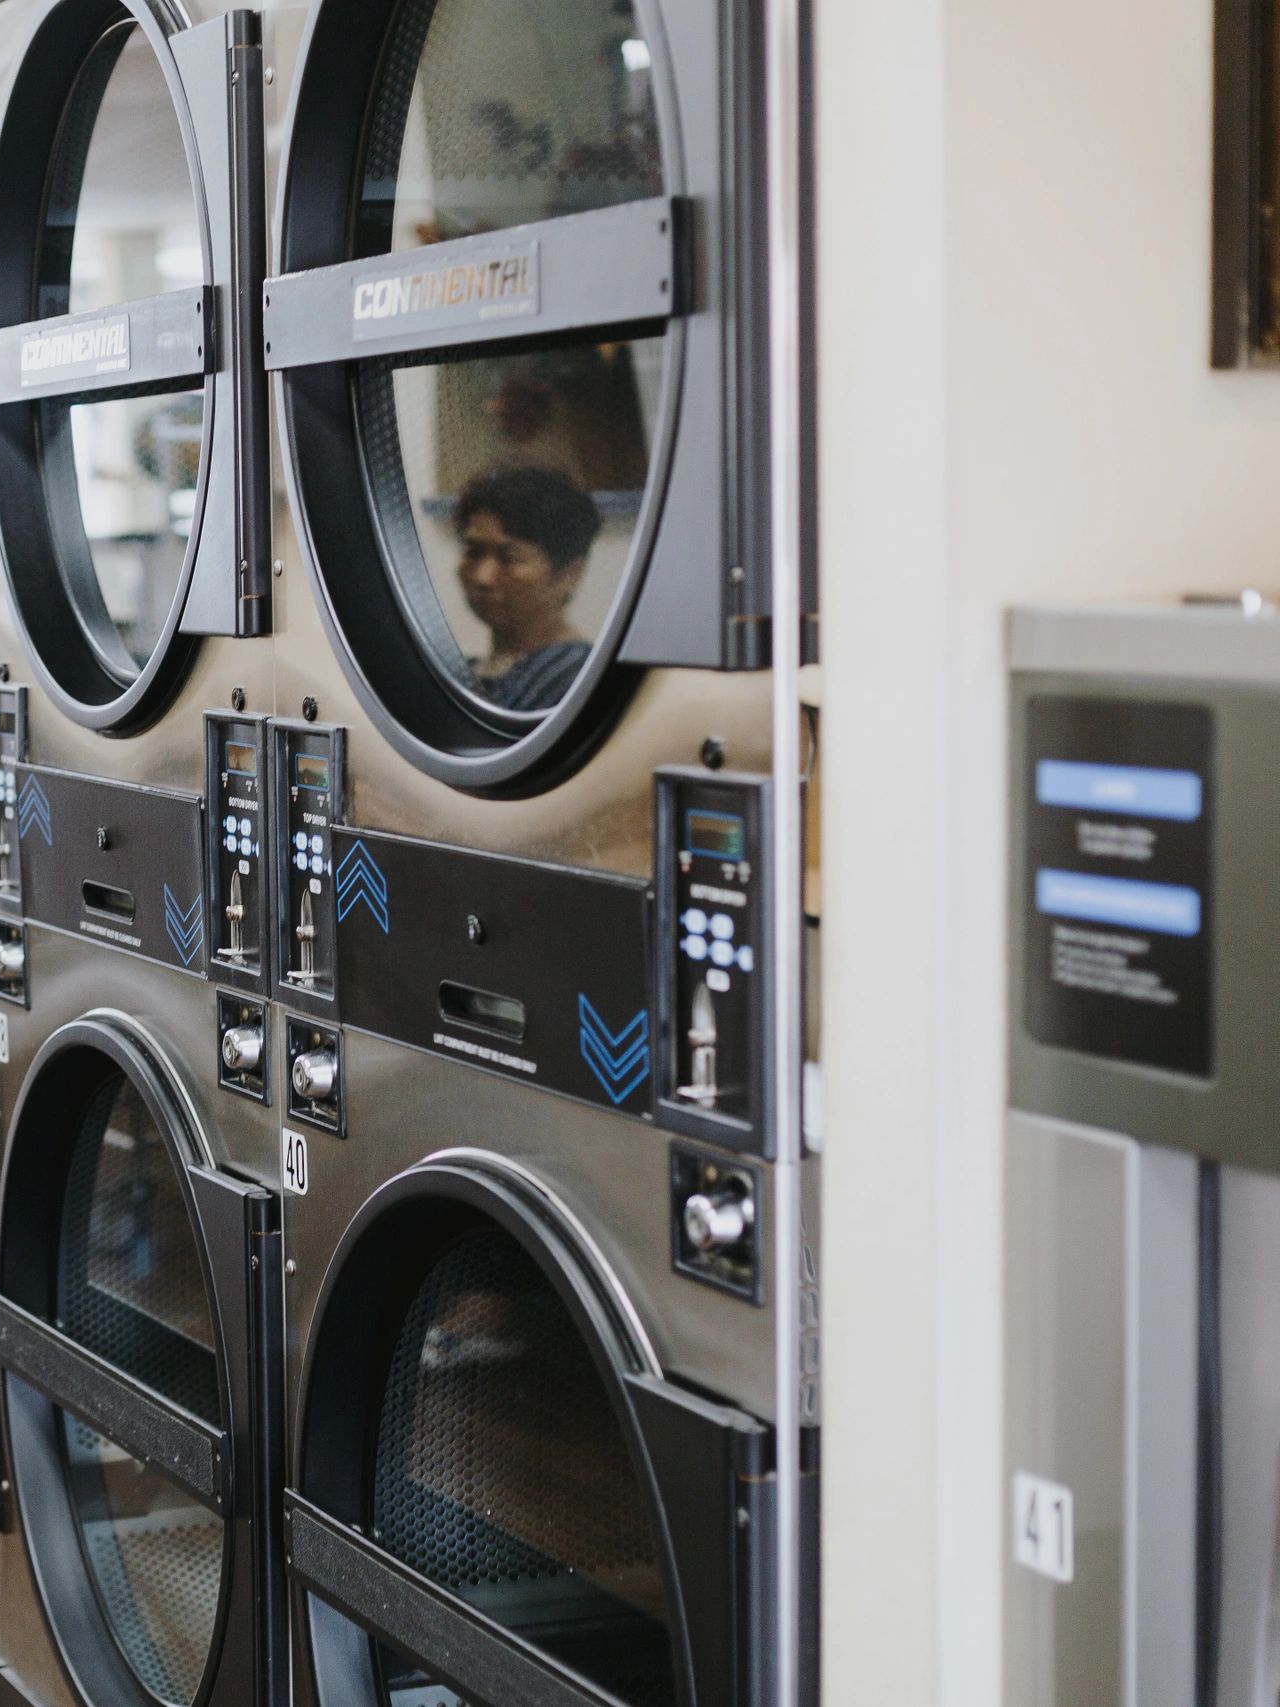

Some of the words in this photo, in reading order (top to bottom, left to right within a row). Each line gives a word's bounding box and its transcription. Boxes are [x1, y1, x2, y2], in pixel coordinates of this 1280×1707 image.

[353, 256, 535, 320] CONTINENTAL
[21, 323, 127, 371] CONTINENTAL
[286, 1135, 305, 1190] 40
[1026, 1487, 1066, 1571] 41
